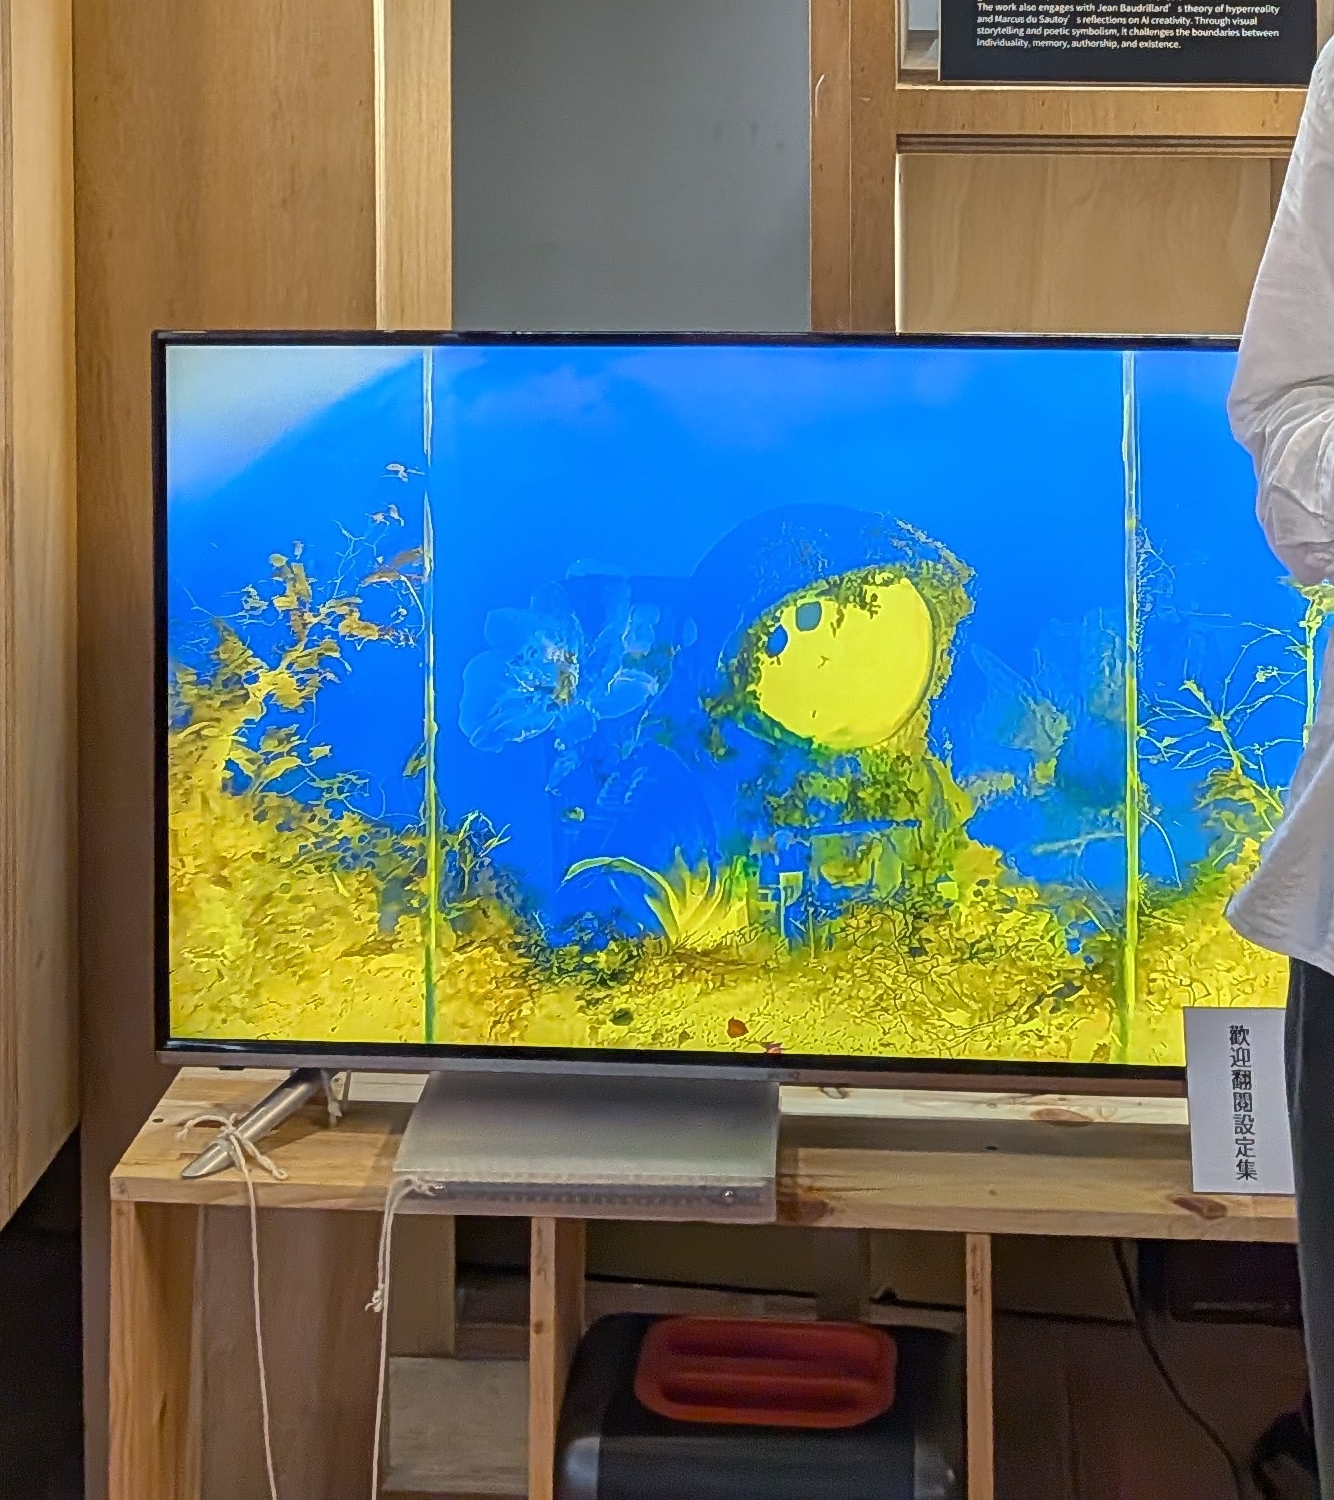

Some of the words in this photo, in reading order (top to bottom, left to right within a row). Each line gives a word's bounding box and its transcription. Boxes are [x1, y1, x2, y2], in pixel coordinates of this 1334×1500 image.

[1228, 1024, 1259, 1182] 歡迎翻閱設定集
